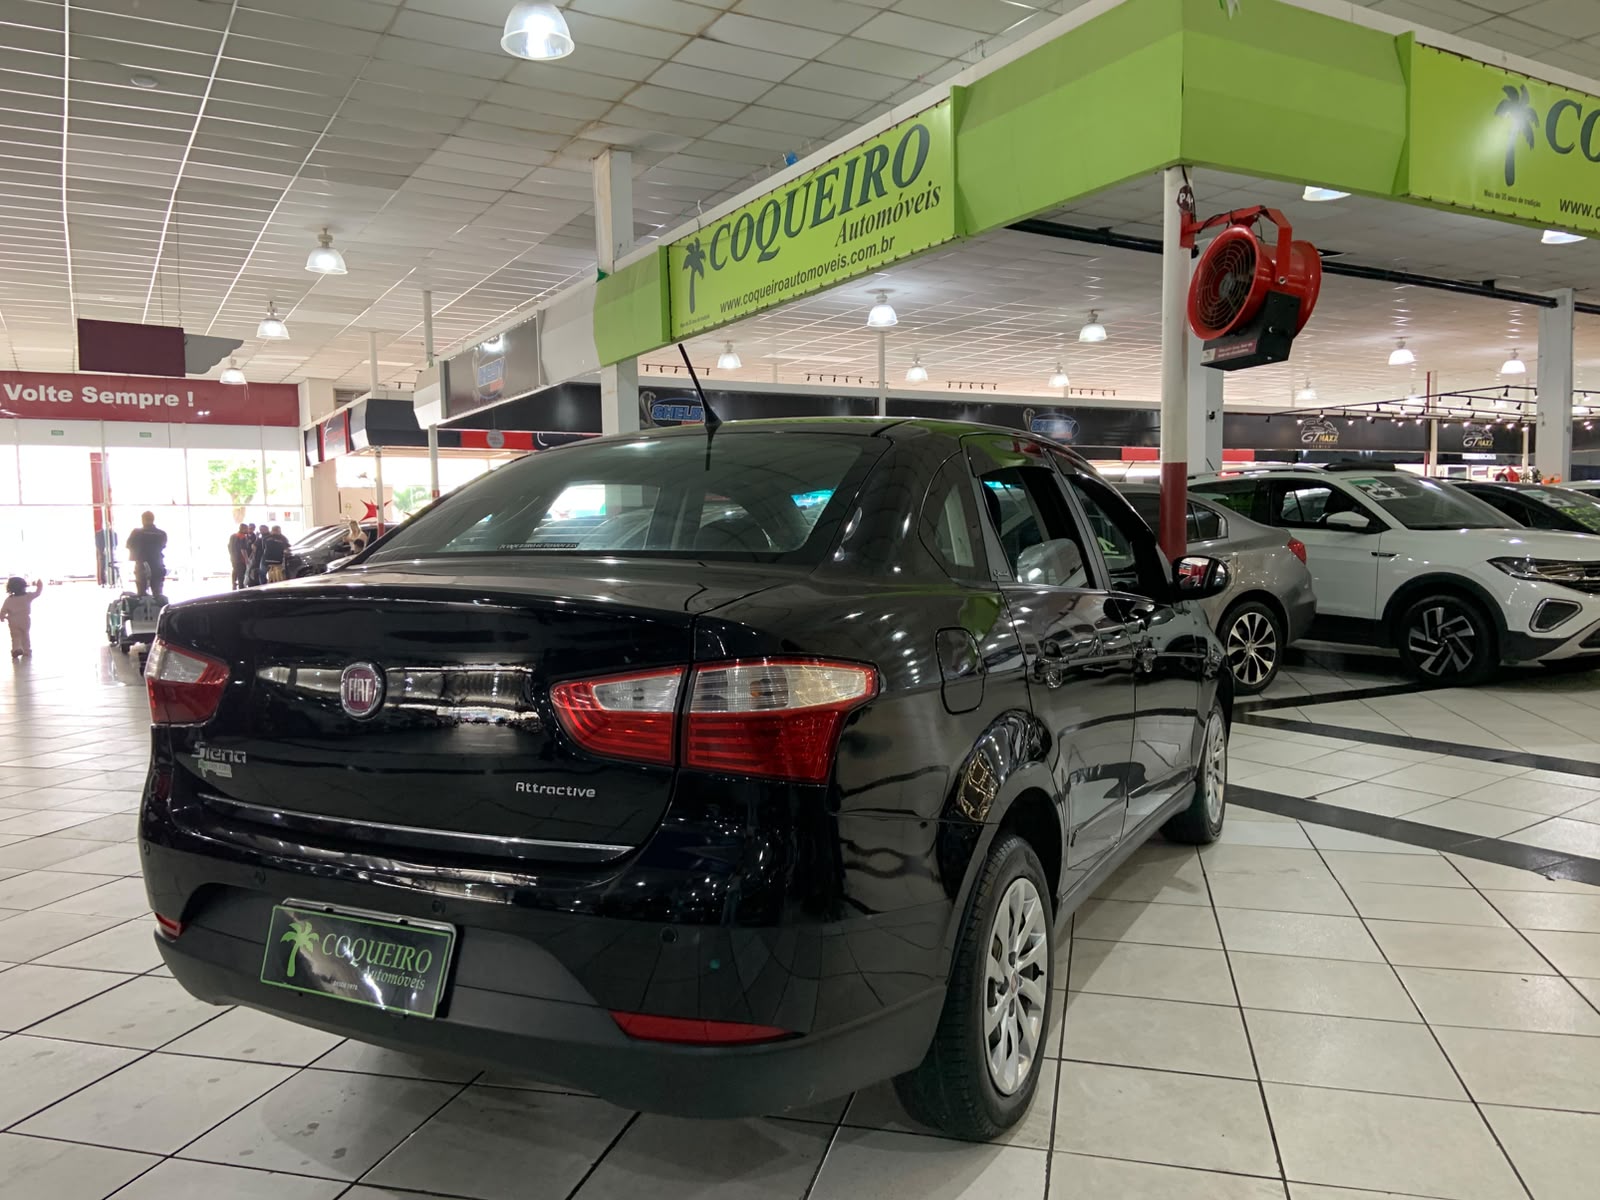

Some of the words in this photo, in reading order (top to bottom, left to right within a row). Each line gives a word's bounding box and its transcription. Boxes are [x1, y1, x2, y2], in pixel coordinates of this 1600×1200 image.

[709, 123, 931, 271] COQUEIRO
[835, 181, 942, 247] Automóveis
[719, 235, 896, 313] www.coqueiroautomoveis.com.br
[3, 383, 73, 402] Volte
[82, 386, 180, 409] Sempre
[187, 391, 194, 407] !
[652, 404, 706, 421] SHELB
[348, 675, 372, 702] FIAT
[191, 741, 247, 764] Siena
[515, 781, 596, 798] Attractive
[321, 933, 433, 975] COQUEIRO
